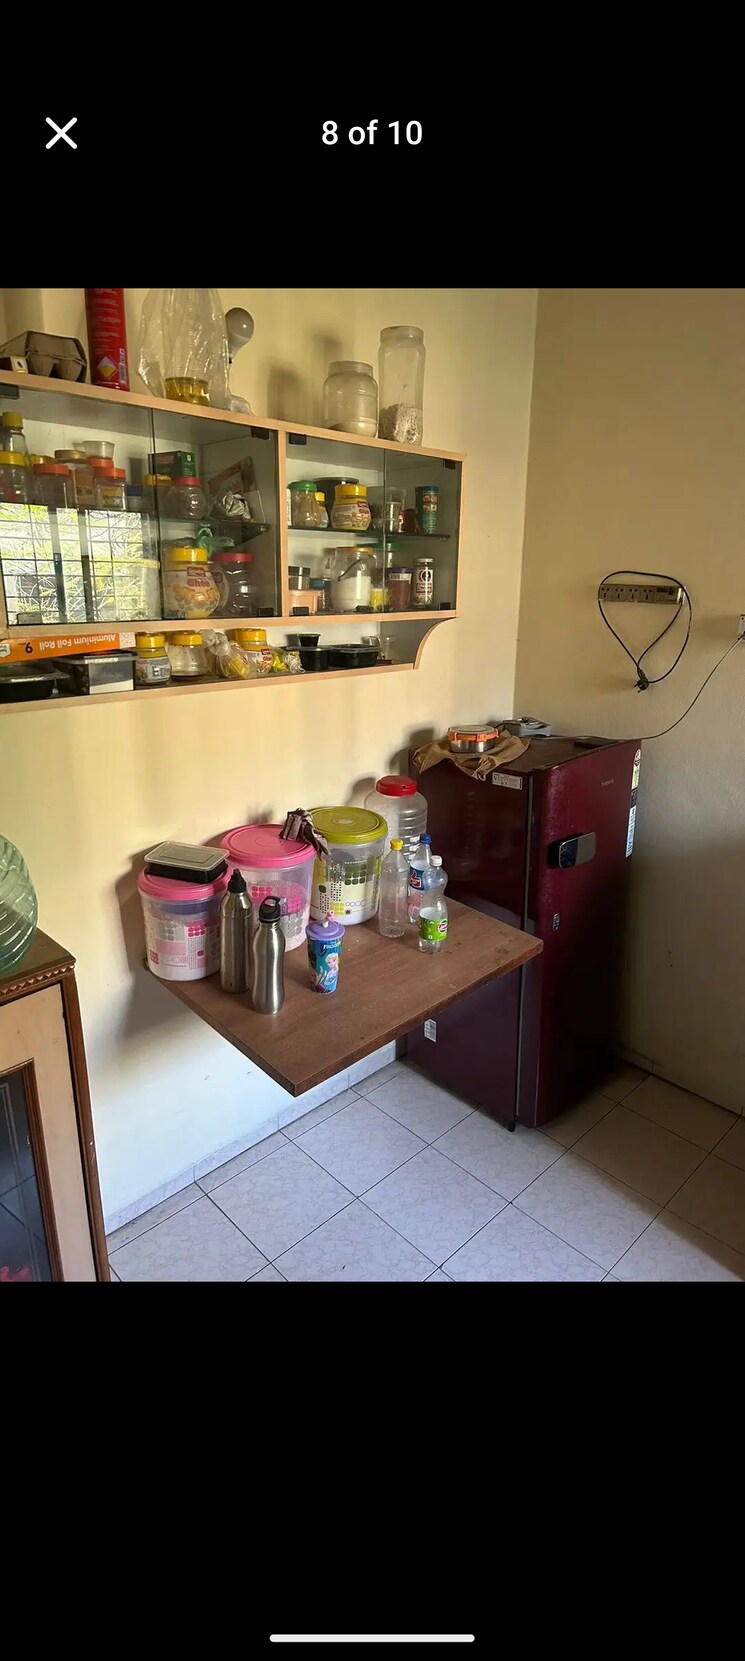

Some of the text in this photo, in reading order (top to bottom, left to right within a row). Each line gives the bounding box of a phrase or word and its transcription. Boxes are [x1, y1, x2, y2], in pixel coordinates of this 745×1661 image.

[24, 633, 116, 654] Aluminium Foil Roll 9
